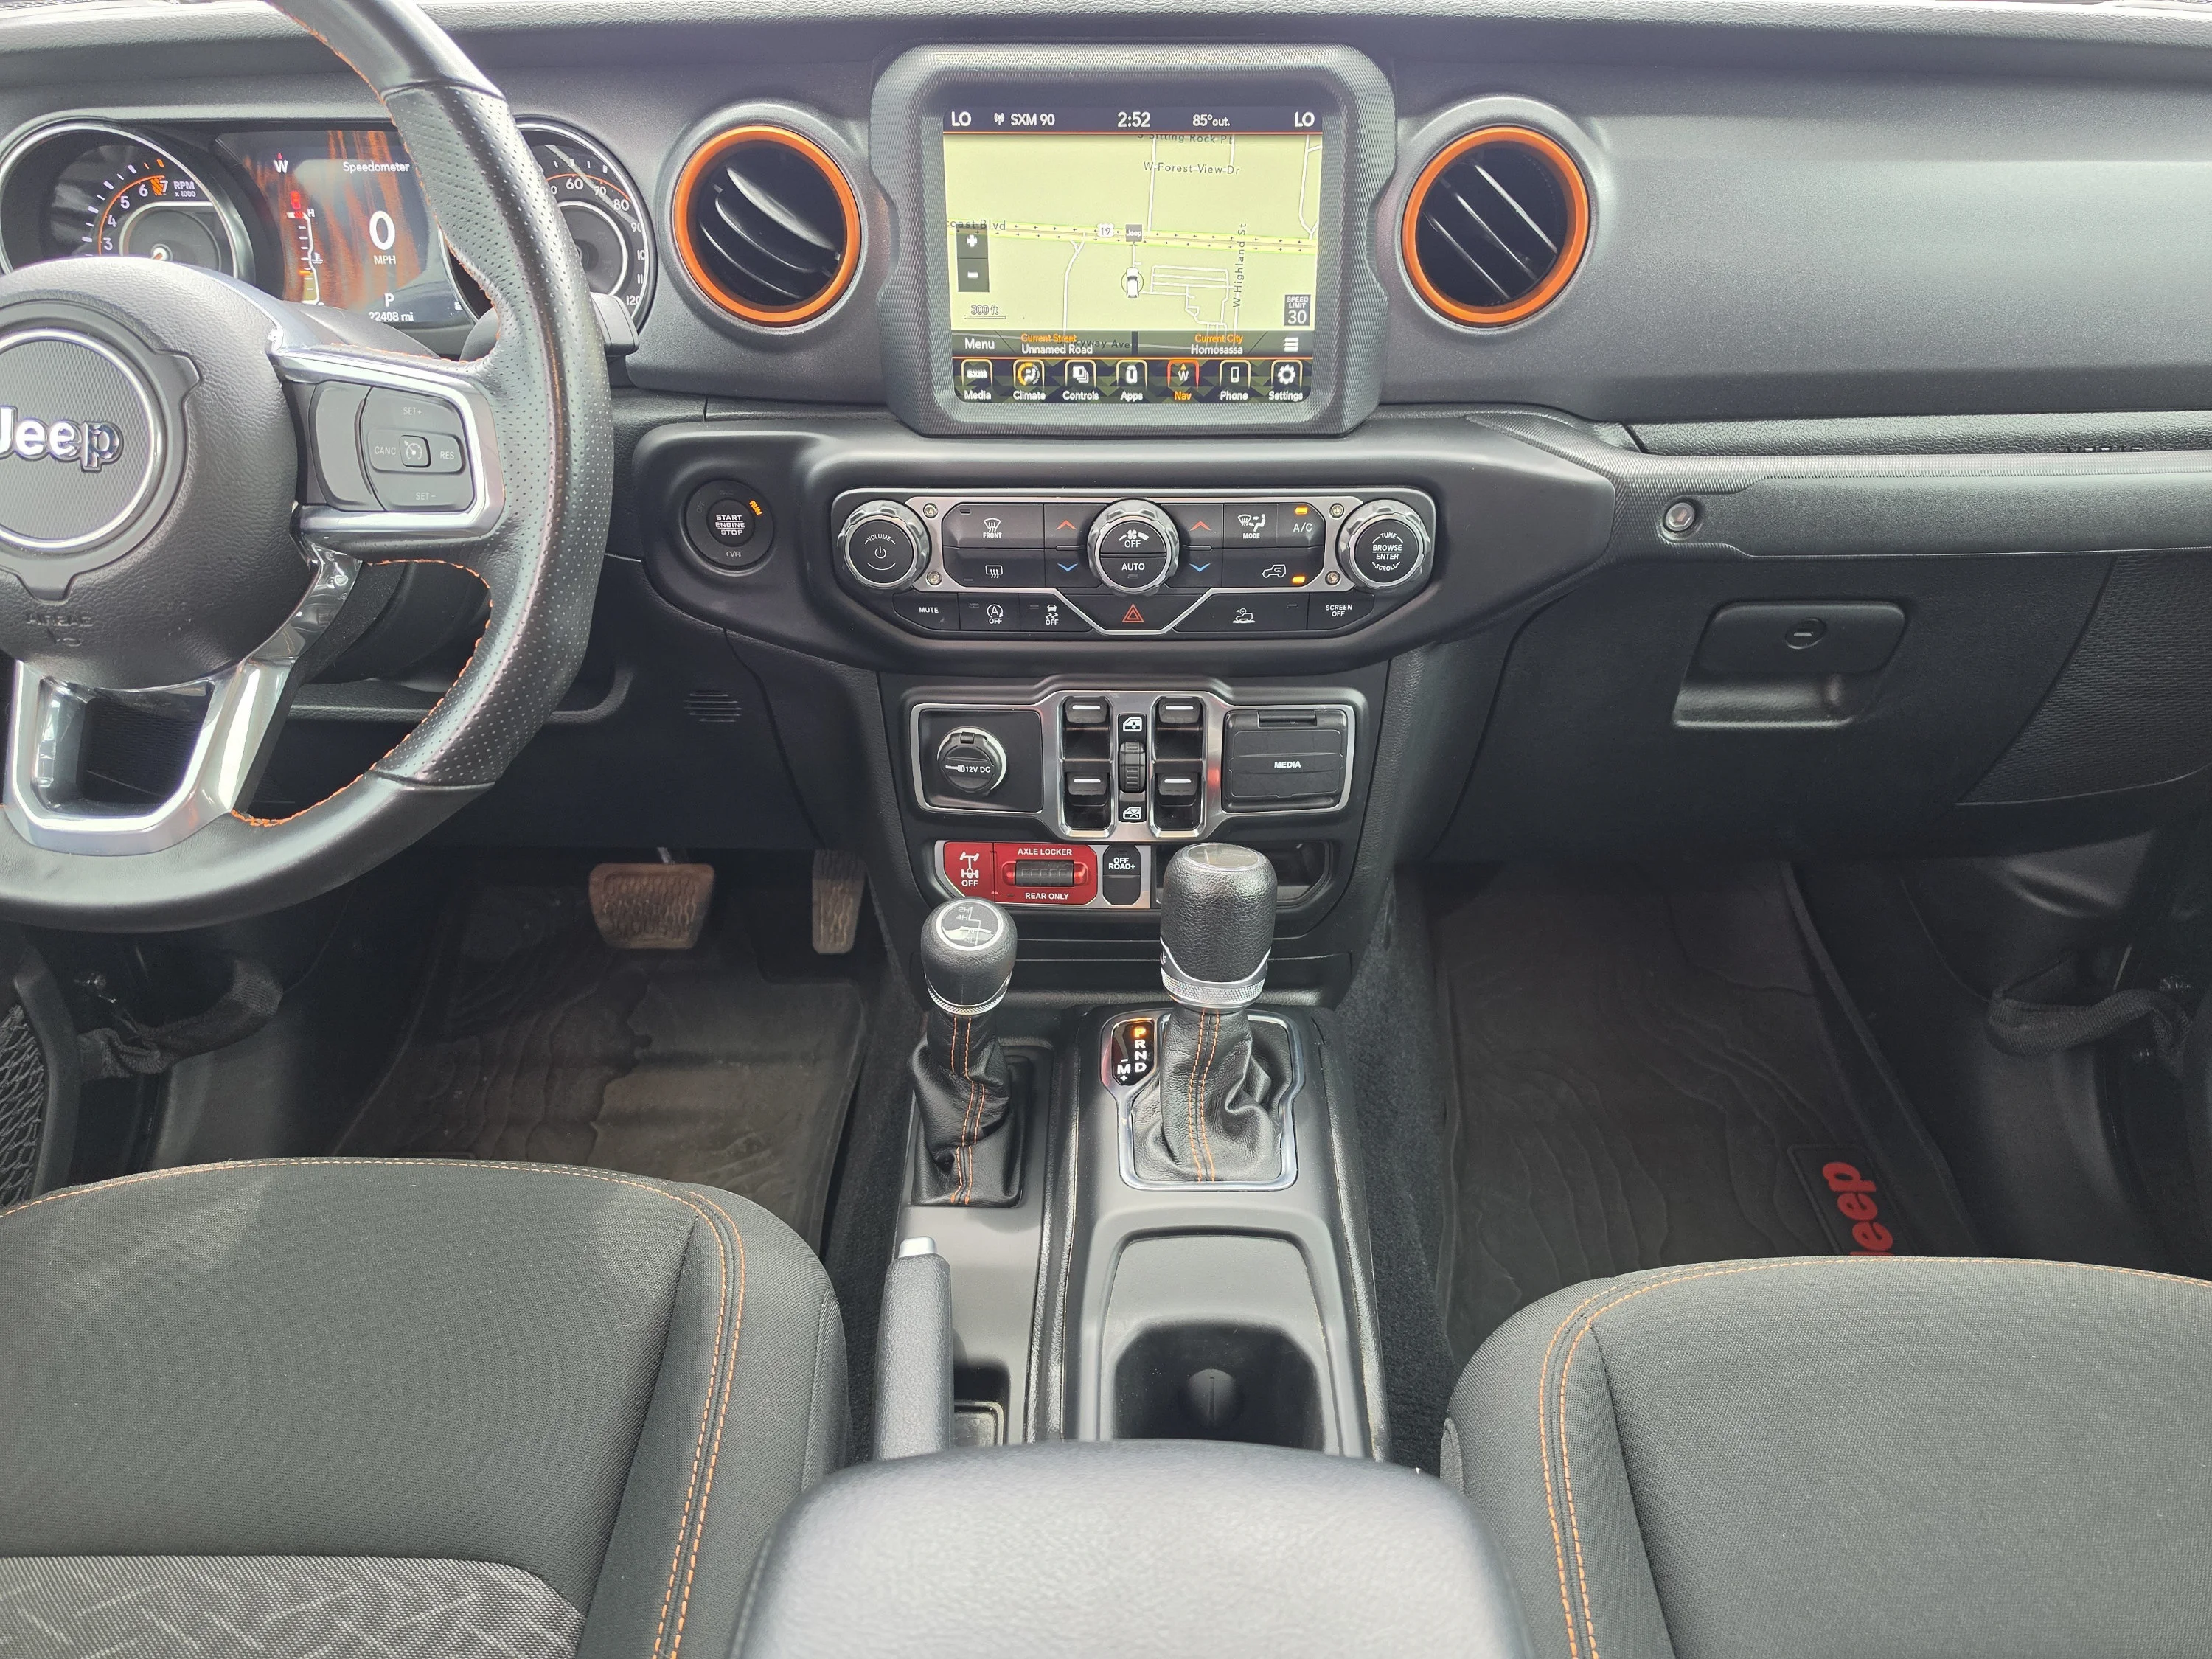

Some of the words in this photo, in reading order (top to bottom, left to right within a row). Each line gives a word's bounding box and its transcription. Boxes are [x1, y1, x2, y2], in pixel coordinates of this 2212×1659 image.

[951, 111, 972, 127] LO
[1010, 113, 1037, 126] SXM
[1040, 113, 1056, 126] 90
[1117, 111, 1151, 128] 2:52
[1295, 111, 1315, 128] LO
[1189, 134, 1215, 144] Rock
[1221, 135, 1233, 145] Pt
[273, 160, 288, 173] W
[343, 161, 410, 174] Speedometer
[1144, 161, 1154, 171] W
[1158, 162, 1192, 173] Forest
[1197, 164, 1222, 174] View
[1227, 165, 1240, 175] Dr
[160, 180, 168, 193] 7
[173, 181, 195, 190] RPM
[566, 178, 584, 189] 60
[139, 184, 147, 197] 6
[594, 186, 606, 196] 70
[120, 196, 130, 209] 5
[613, 199, 630, 212] 80
[307, 209, 315, 218] H
[108, 215, 116, 227] 4
[980, 220, 1006, 230] Blvd
[369, 210, 395, 250] 0
[1101, 227, 1111, 236] 19
[1126, 227, 1142, 237] Jeep
[1238, 223, 1246, 236] St
[104, 237, 113, 251] 3
[374, 255, 397, 265] MPH
[1234, 241, 1245, 293] Highland
[385, 293, 394, 307] P
[971, 305, 990, 316] 300
[990, 305, 999, 316] ft
[369, 312, 399, 322] 22408
[401, 312, 414, 322] mi
[1287, 310, 1307, 324] 30
[964, 338, 995, 349] Menu
[1021, 334, 1052, 343] Current
[1053, 334, 1077, 343] Street
[1194, 335, 1225, 344] Current
[1226, 334, 1243, 344] City
[1021, 344, 1066, 355] Unnamed
[1069, 344, 1093, 355] Road
[1111, 340, 1130, 349] Ave
[1191, 345, 1243, 355] Homosassa
[964, 390, 992, 400] Media
[1013, 390, 1046, 400] Climate
[1062, 390, 1099, 401] Controls
[1120, 391, 1143, 402] Apps
[1174, 391, 1192, 400] Nav
[1220, 391, 1248, 400] Phone
[1268, 391, 1304, 402] Settings
[0, 407, 120, 467] Jeep
[374, 446, 397, 456] CANC
[440, 451, 455, 460] RES
[748, 500, 762, 515] RUN
[1293, 523, 1312, 533] A/C
[866, 533, 891, 542] VOLUME
[1124, 540, 1141, 549] OFF
[1121, 563, 1145, 571] AUTO
[1374, 563, 1398, 571] SCROLL
[1274, 761, 1301, 769] MEDIA
[1135, 1027, 1146, 1038] P
[1135, 1039, 1146, 1048] R
[1135, 1051, 1147, 1060] N
[1117, 1064, 1131, 1074] M
[1135, 1062, 1147, 1072] D
[1822, 1161, 1893, 1256] eep
